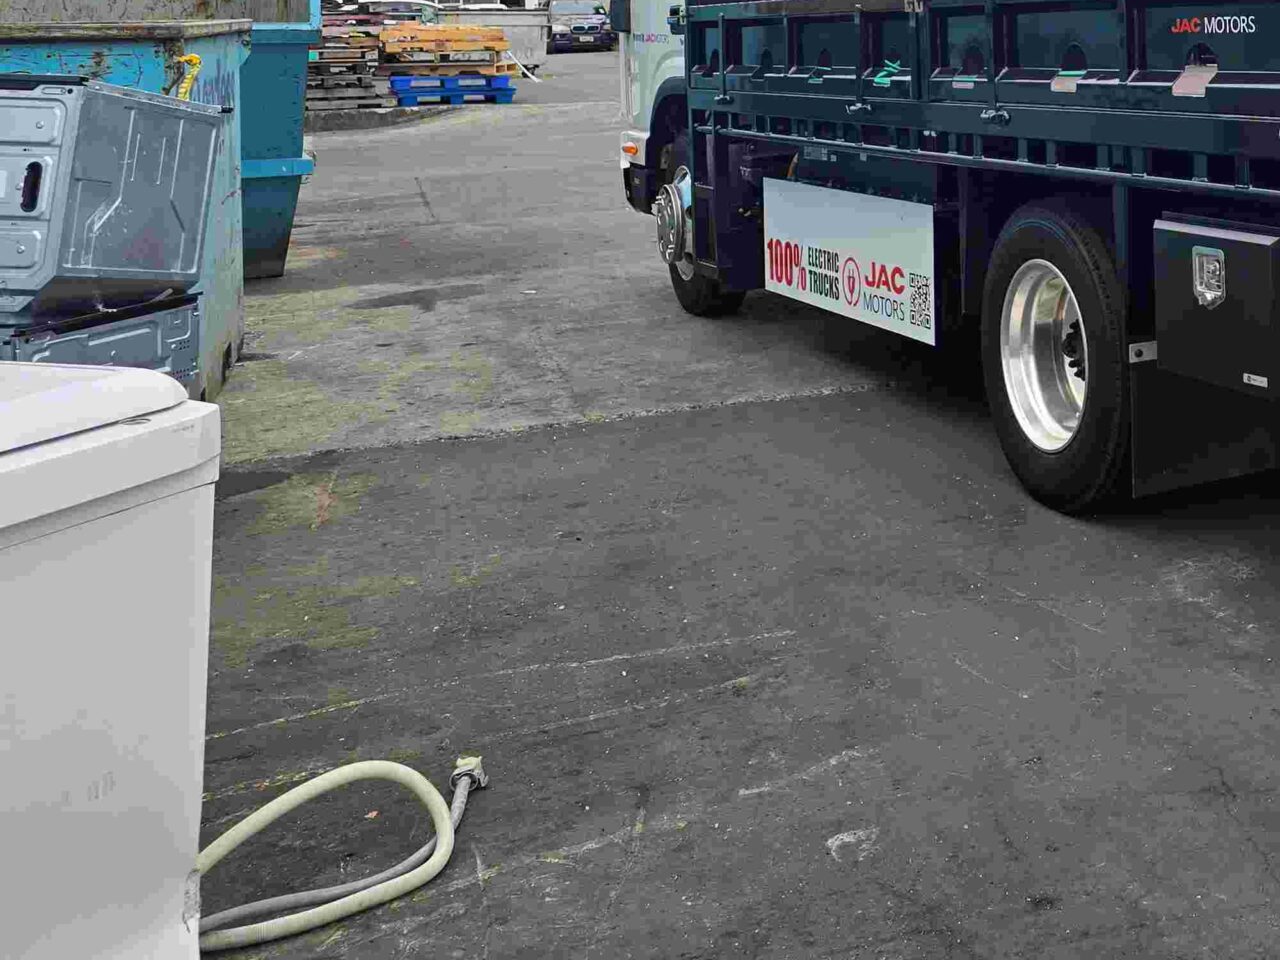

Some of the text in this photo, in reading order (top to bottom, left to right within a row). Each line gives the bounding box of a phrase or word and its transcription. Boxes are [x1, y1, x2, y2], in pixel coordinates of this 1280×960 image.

[1171, 15, 1256, 34] JAC MOTORS
[767, 237, 807, 291] 100%
[807, 246, 840, 274] ELECTRIC
[808, 269, 841, 301] TRUCKS
[864, 261, 906, 296] JAC
[863, 291, 906, 322] MOTORS
